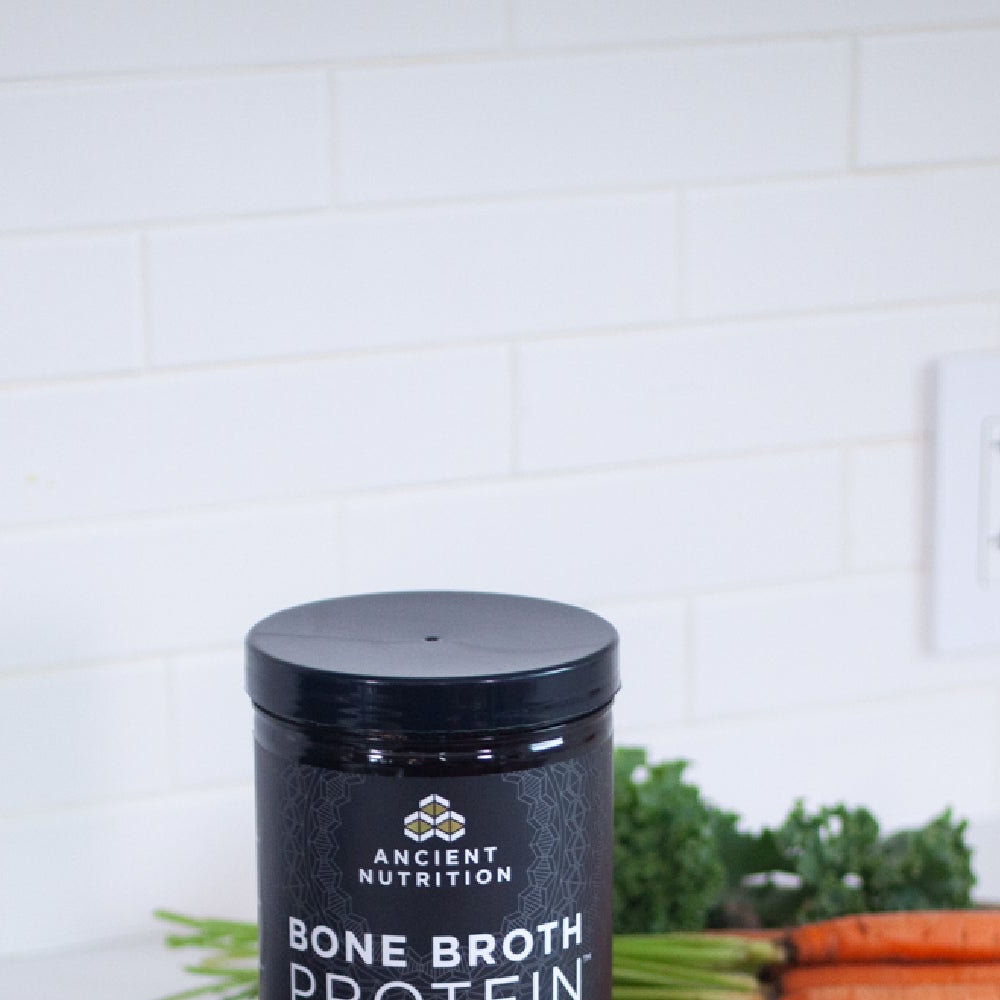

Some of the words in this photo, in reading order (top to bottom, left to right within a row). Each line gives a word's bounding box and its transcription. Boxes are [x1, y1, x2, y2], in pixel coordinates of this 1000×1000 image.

[374, 846, 498, 866] ANCIENT
[359, 866, 512, 887] NUTRITION
[289, 916, 407, 967] BONE
[432, 913, 583, 967] BROTH
